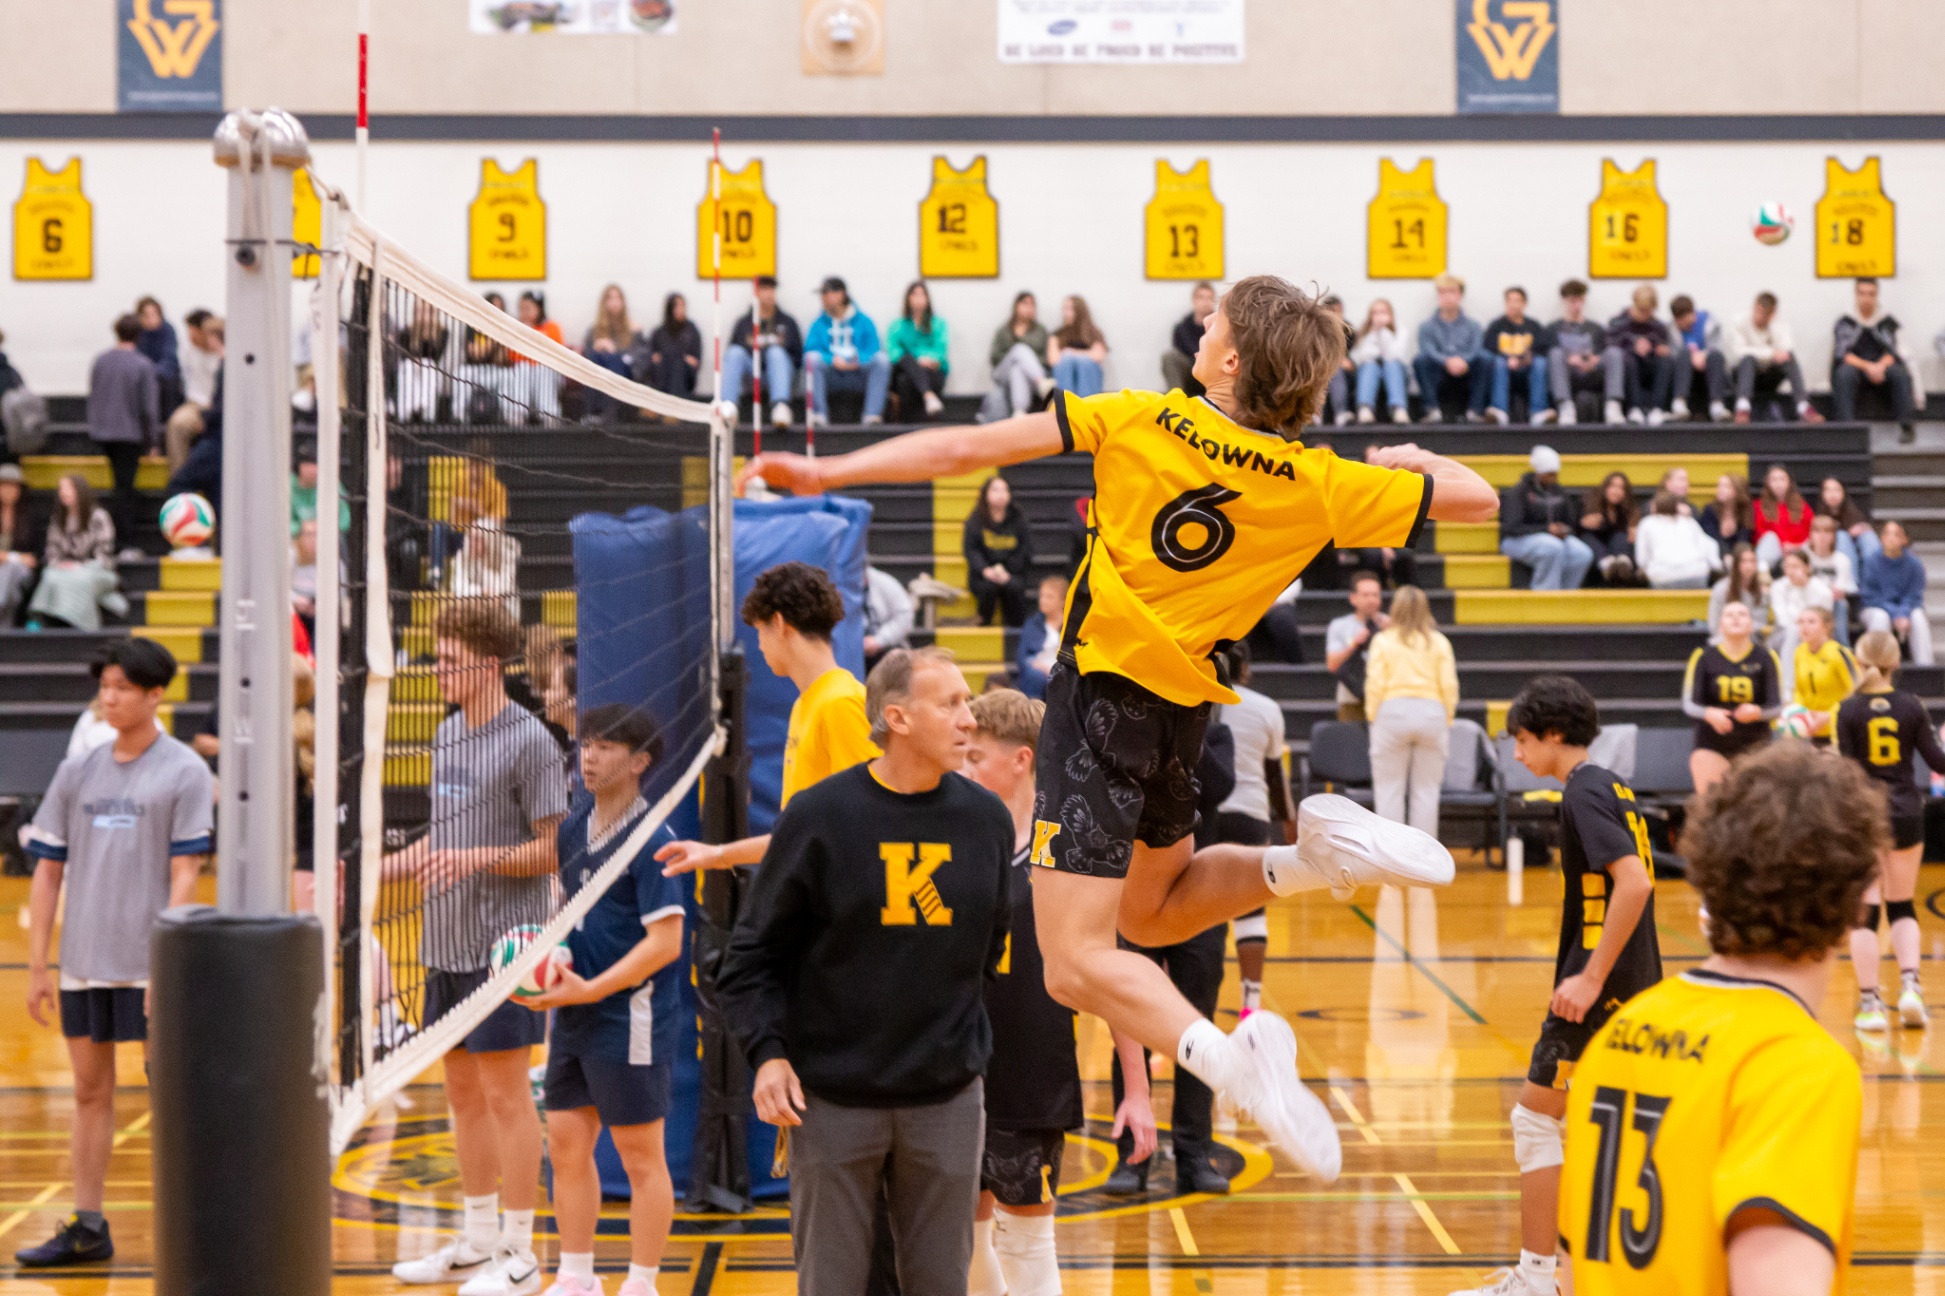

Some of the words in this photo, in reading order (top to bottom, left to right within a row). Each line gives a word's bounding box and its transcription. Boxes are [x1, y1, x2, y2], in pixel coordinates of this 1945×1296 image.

[43, 217, 64, 253] 6
[498, 212, 516, 243] 9
[722, 209, 753, 243] 10
[937, 202, 967, 234] 12
[1389, 218, 1426, 249] 14
[1605, 212, 1640, 243] 16
[1830, 218, 1864, 246] 18
[1168, 224, 1200, 258] 13
[1155, 406, 1296, 482] KELOWNA
[1150, 481, 1243, 573] 6
[1717, 675, 1754, 703] 19
[1867, 717, 1901, 766] 6
[1029, 818, 1062, 868] K
[878, 842, 953, 927] K
[1584, 1084, 1673, 1271] 13
